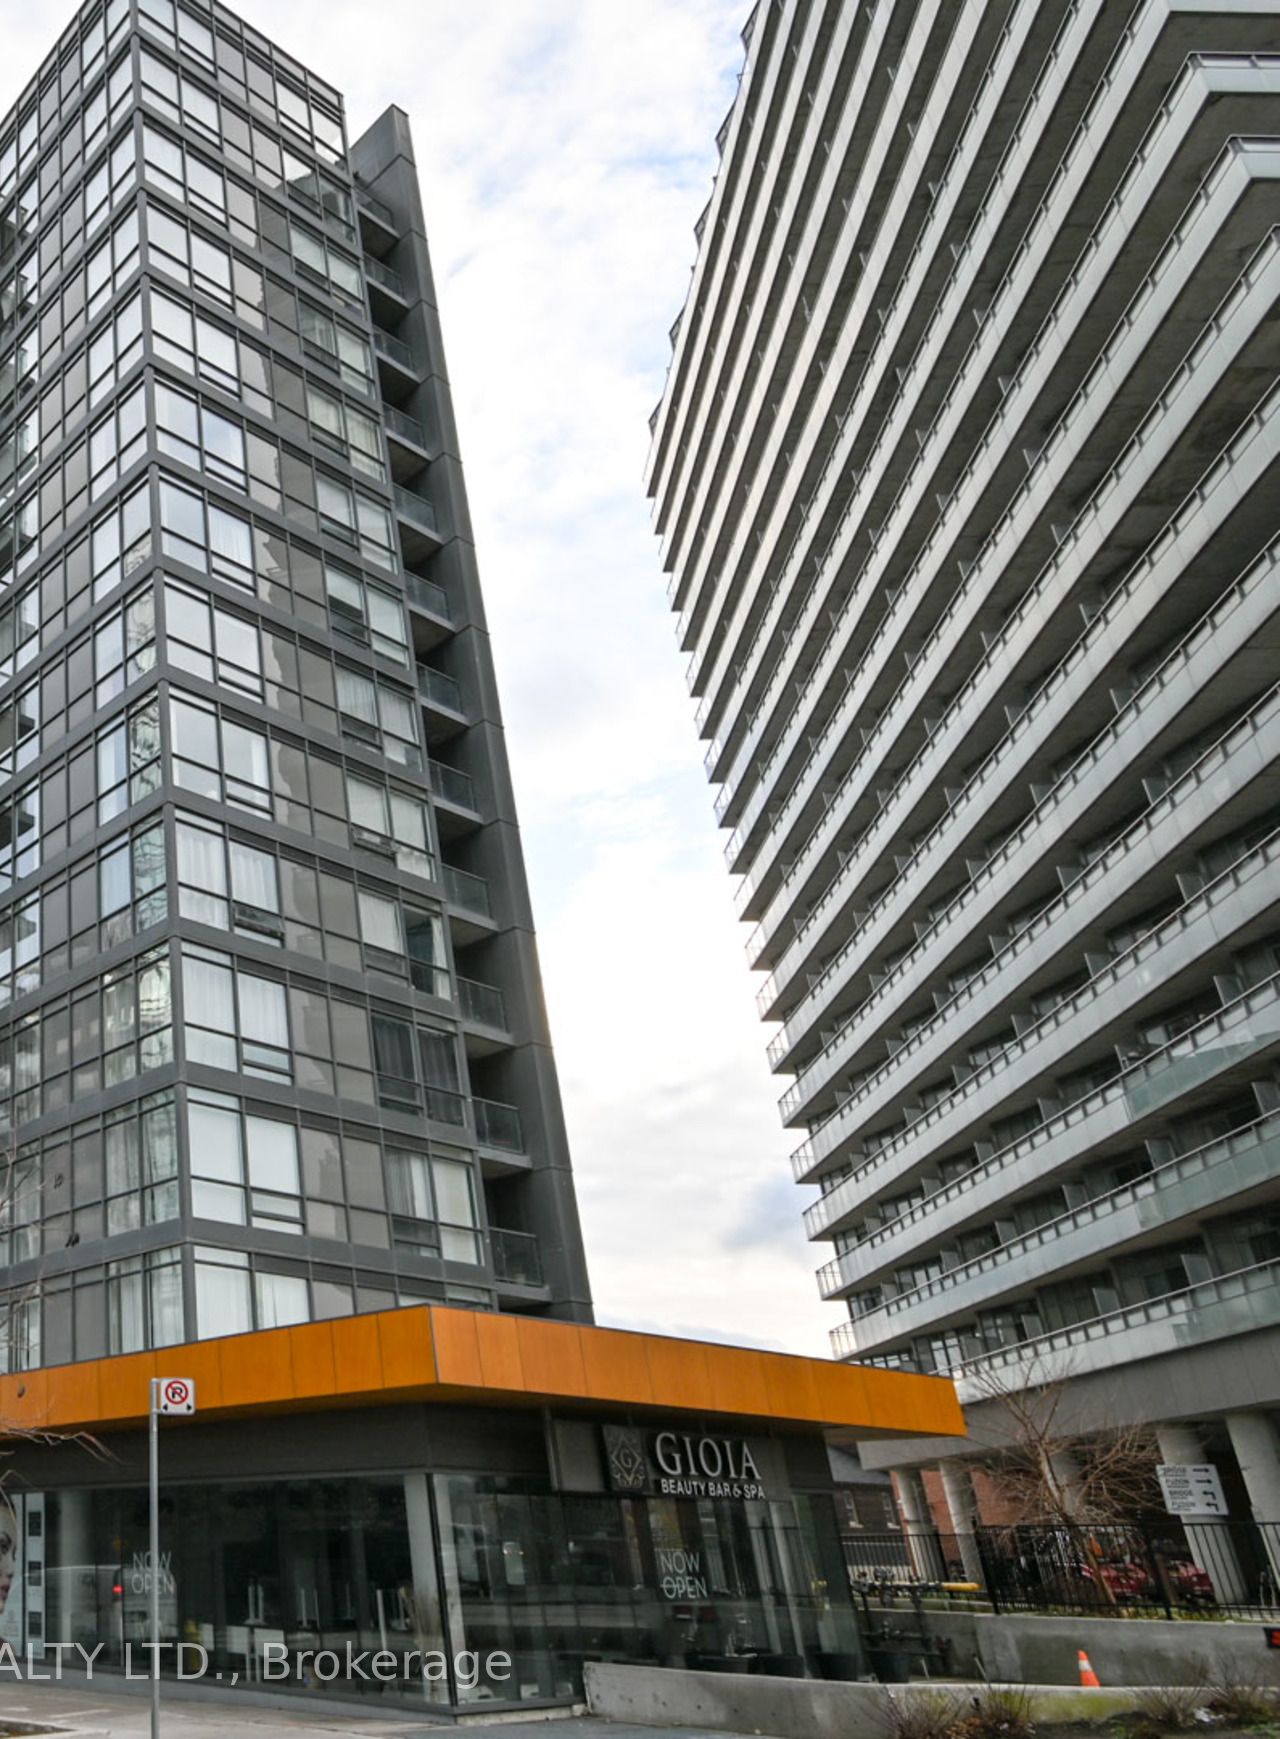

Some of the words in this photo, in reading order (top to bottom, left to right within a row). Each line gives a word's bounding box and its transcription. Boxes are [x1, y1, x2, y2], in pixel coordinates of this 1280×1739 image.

[655, 1432, 762, 1480] GIOIA
[661, 1478, 706, 1496] BEAUTY
[708, 1482, 732, 1497] BAR
[733, 1484, 743, 1498] &
[744, 1485, 765, 1499] SPA
[660, 1552, 700, 1574] NOW
[663, 1576, 708, 1599] OPEN
